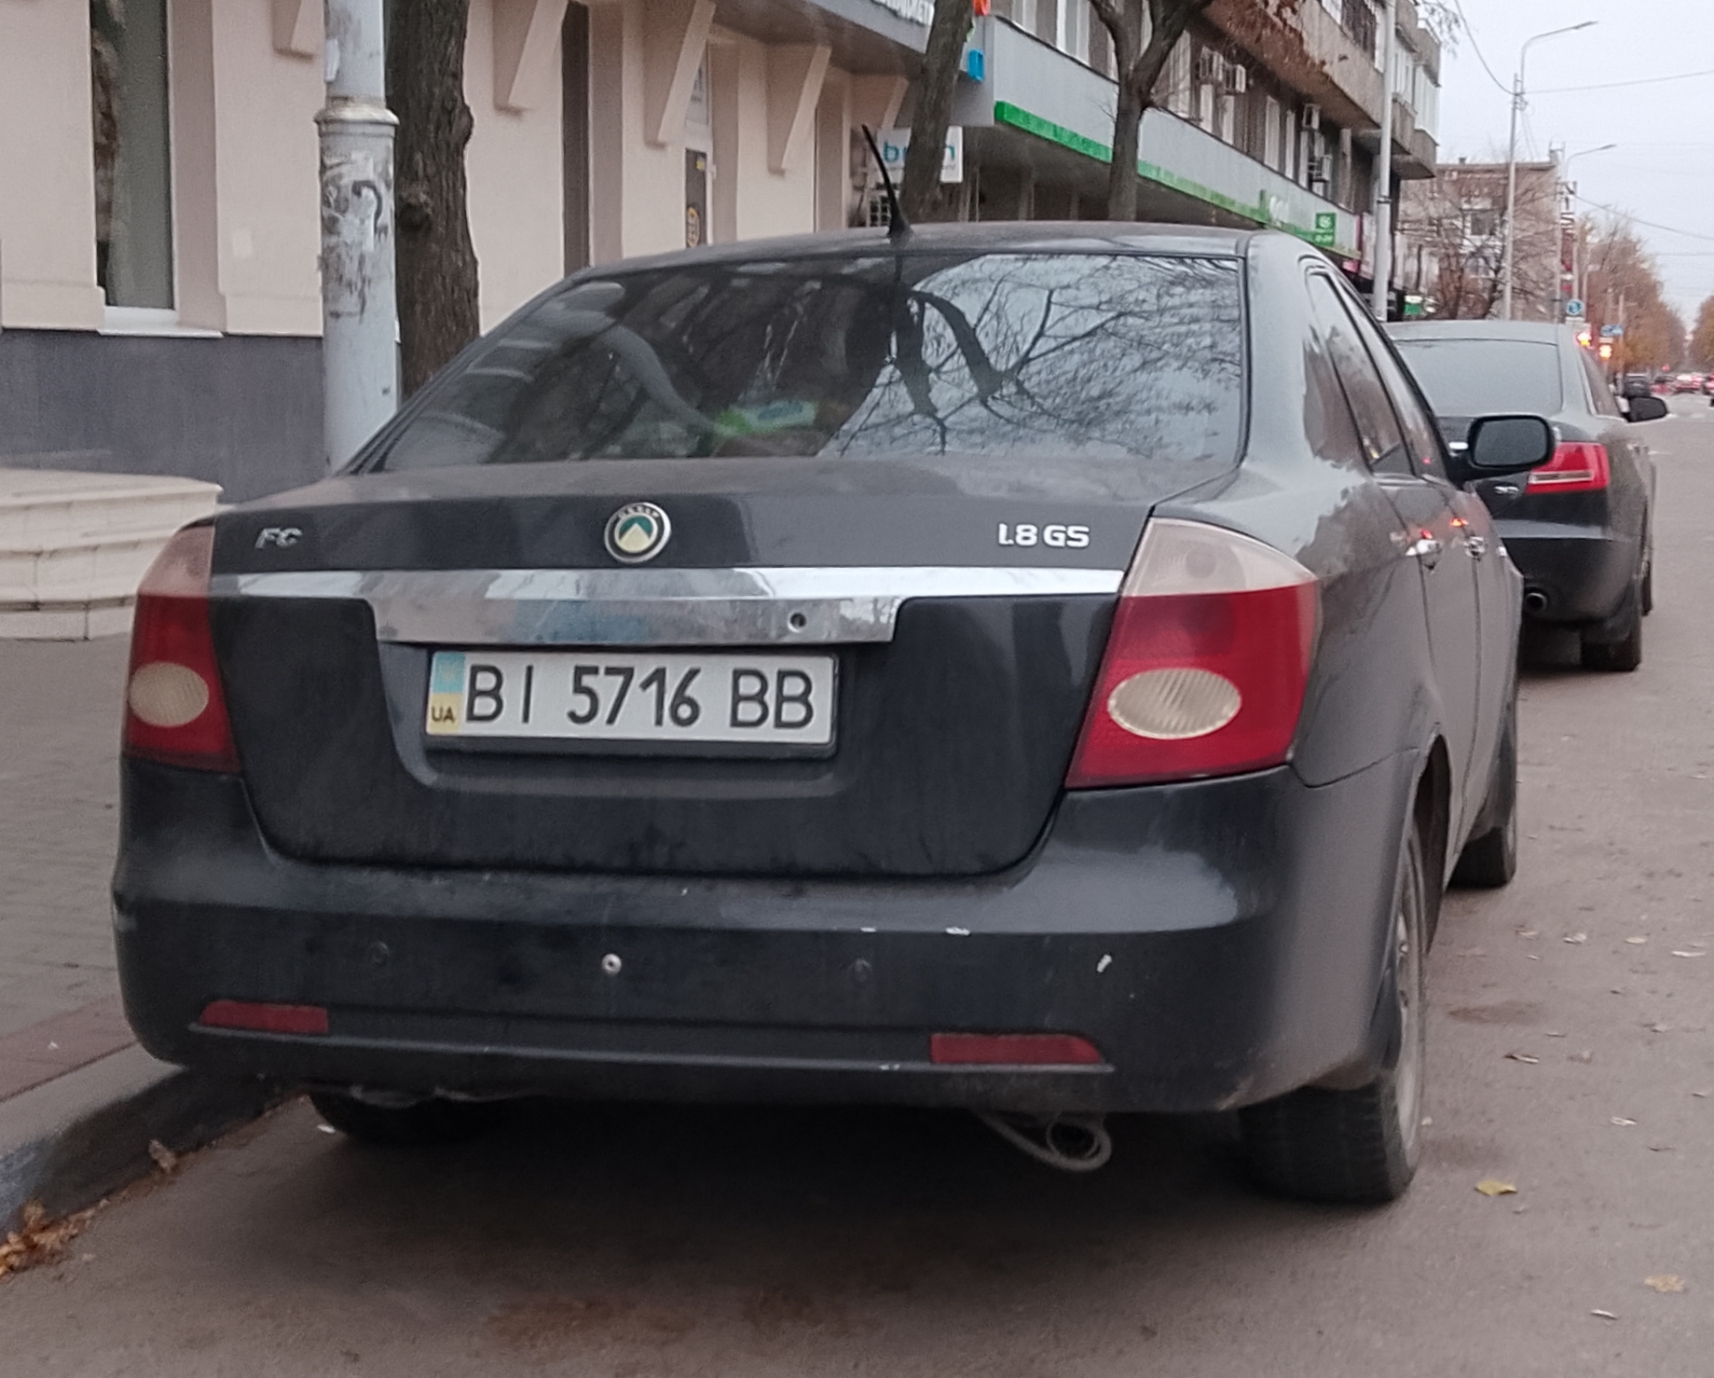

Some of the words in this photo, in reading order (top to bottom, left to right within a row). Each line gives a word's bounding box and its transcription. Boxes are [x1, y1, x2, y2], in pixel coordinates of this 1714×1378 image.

[1043, 524, 1090, 548] GS
[465, 664, 535, 724] BI
[567, 665, 702, 728] 5716
[730, 668, 815, 729] BB
[431, 705, 456, 723] UA
